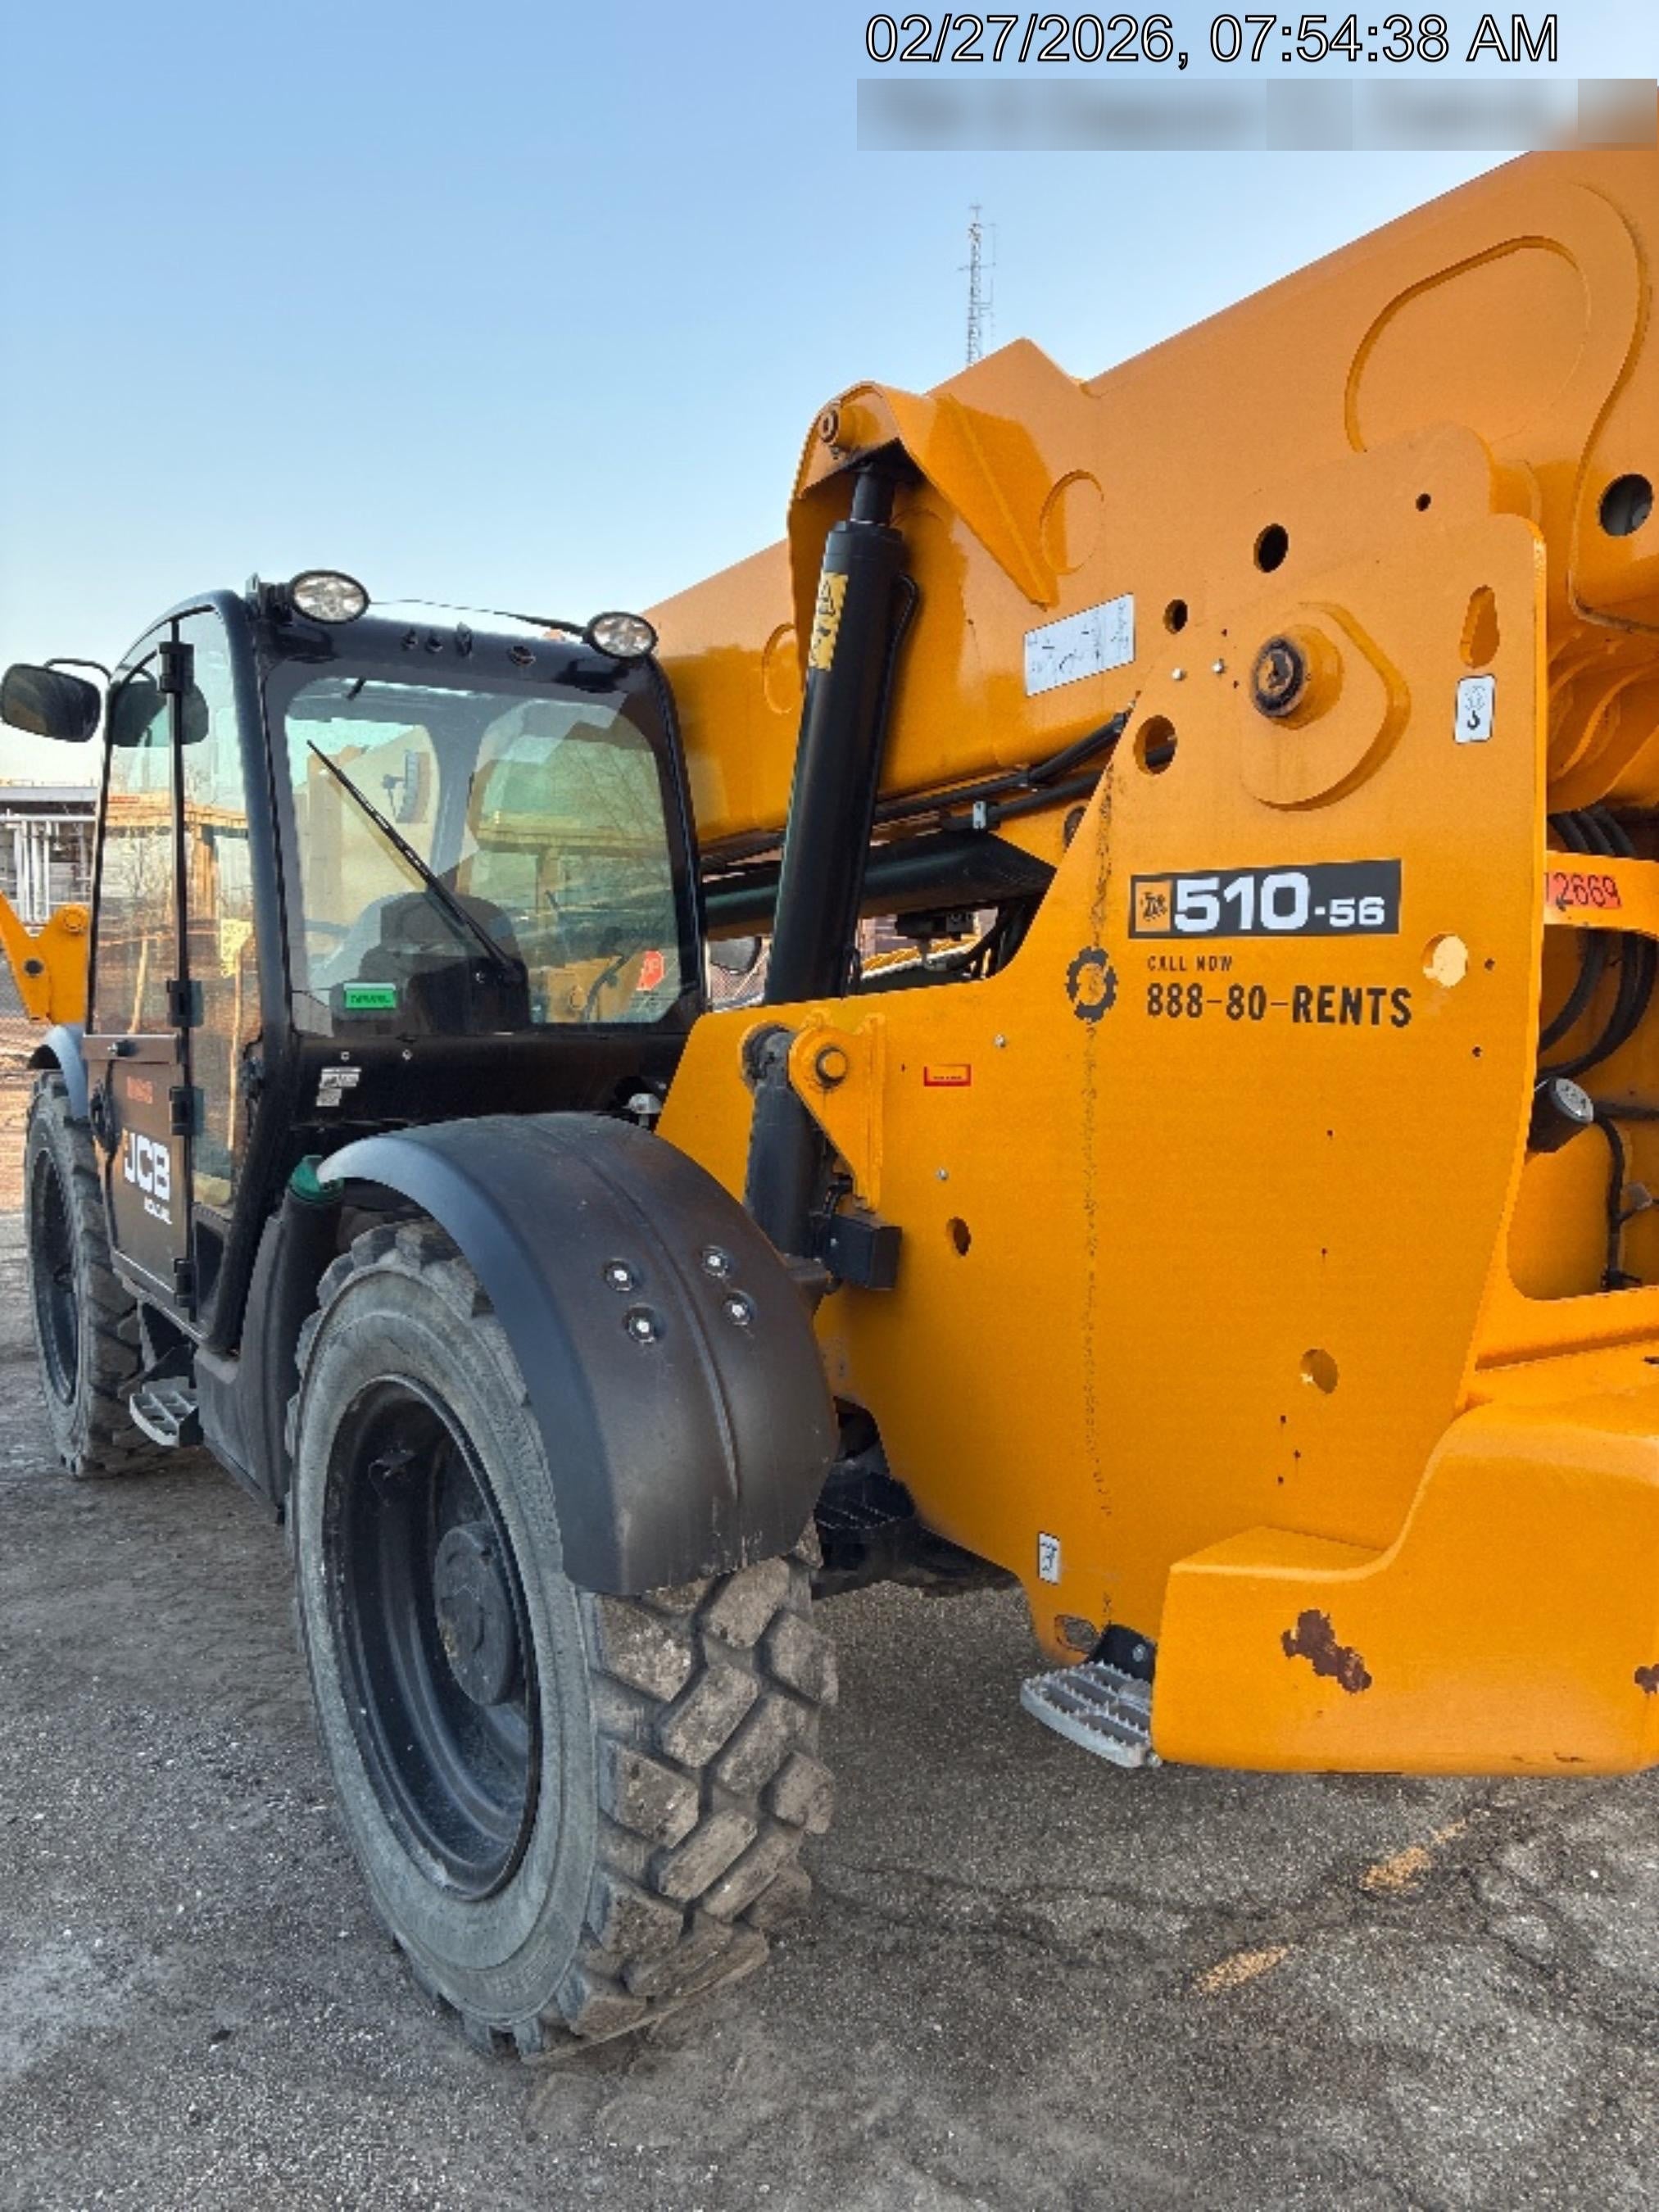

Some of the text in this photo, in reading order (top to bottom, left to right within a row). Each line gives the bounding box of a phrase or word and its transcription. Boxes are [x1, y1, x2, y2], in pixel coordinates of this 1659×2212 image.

[1147, 955, 1233, 972] CALL NOW
[1147, 982, 1412, 1028] 888-80-RENTS
[124, 1132, 171, 1202] JCB
